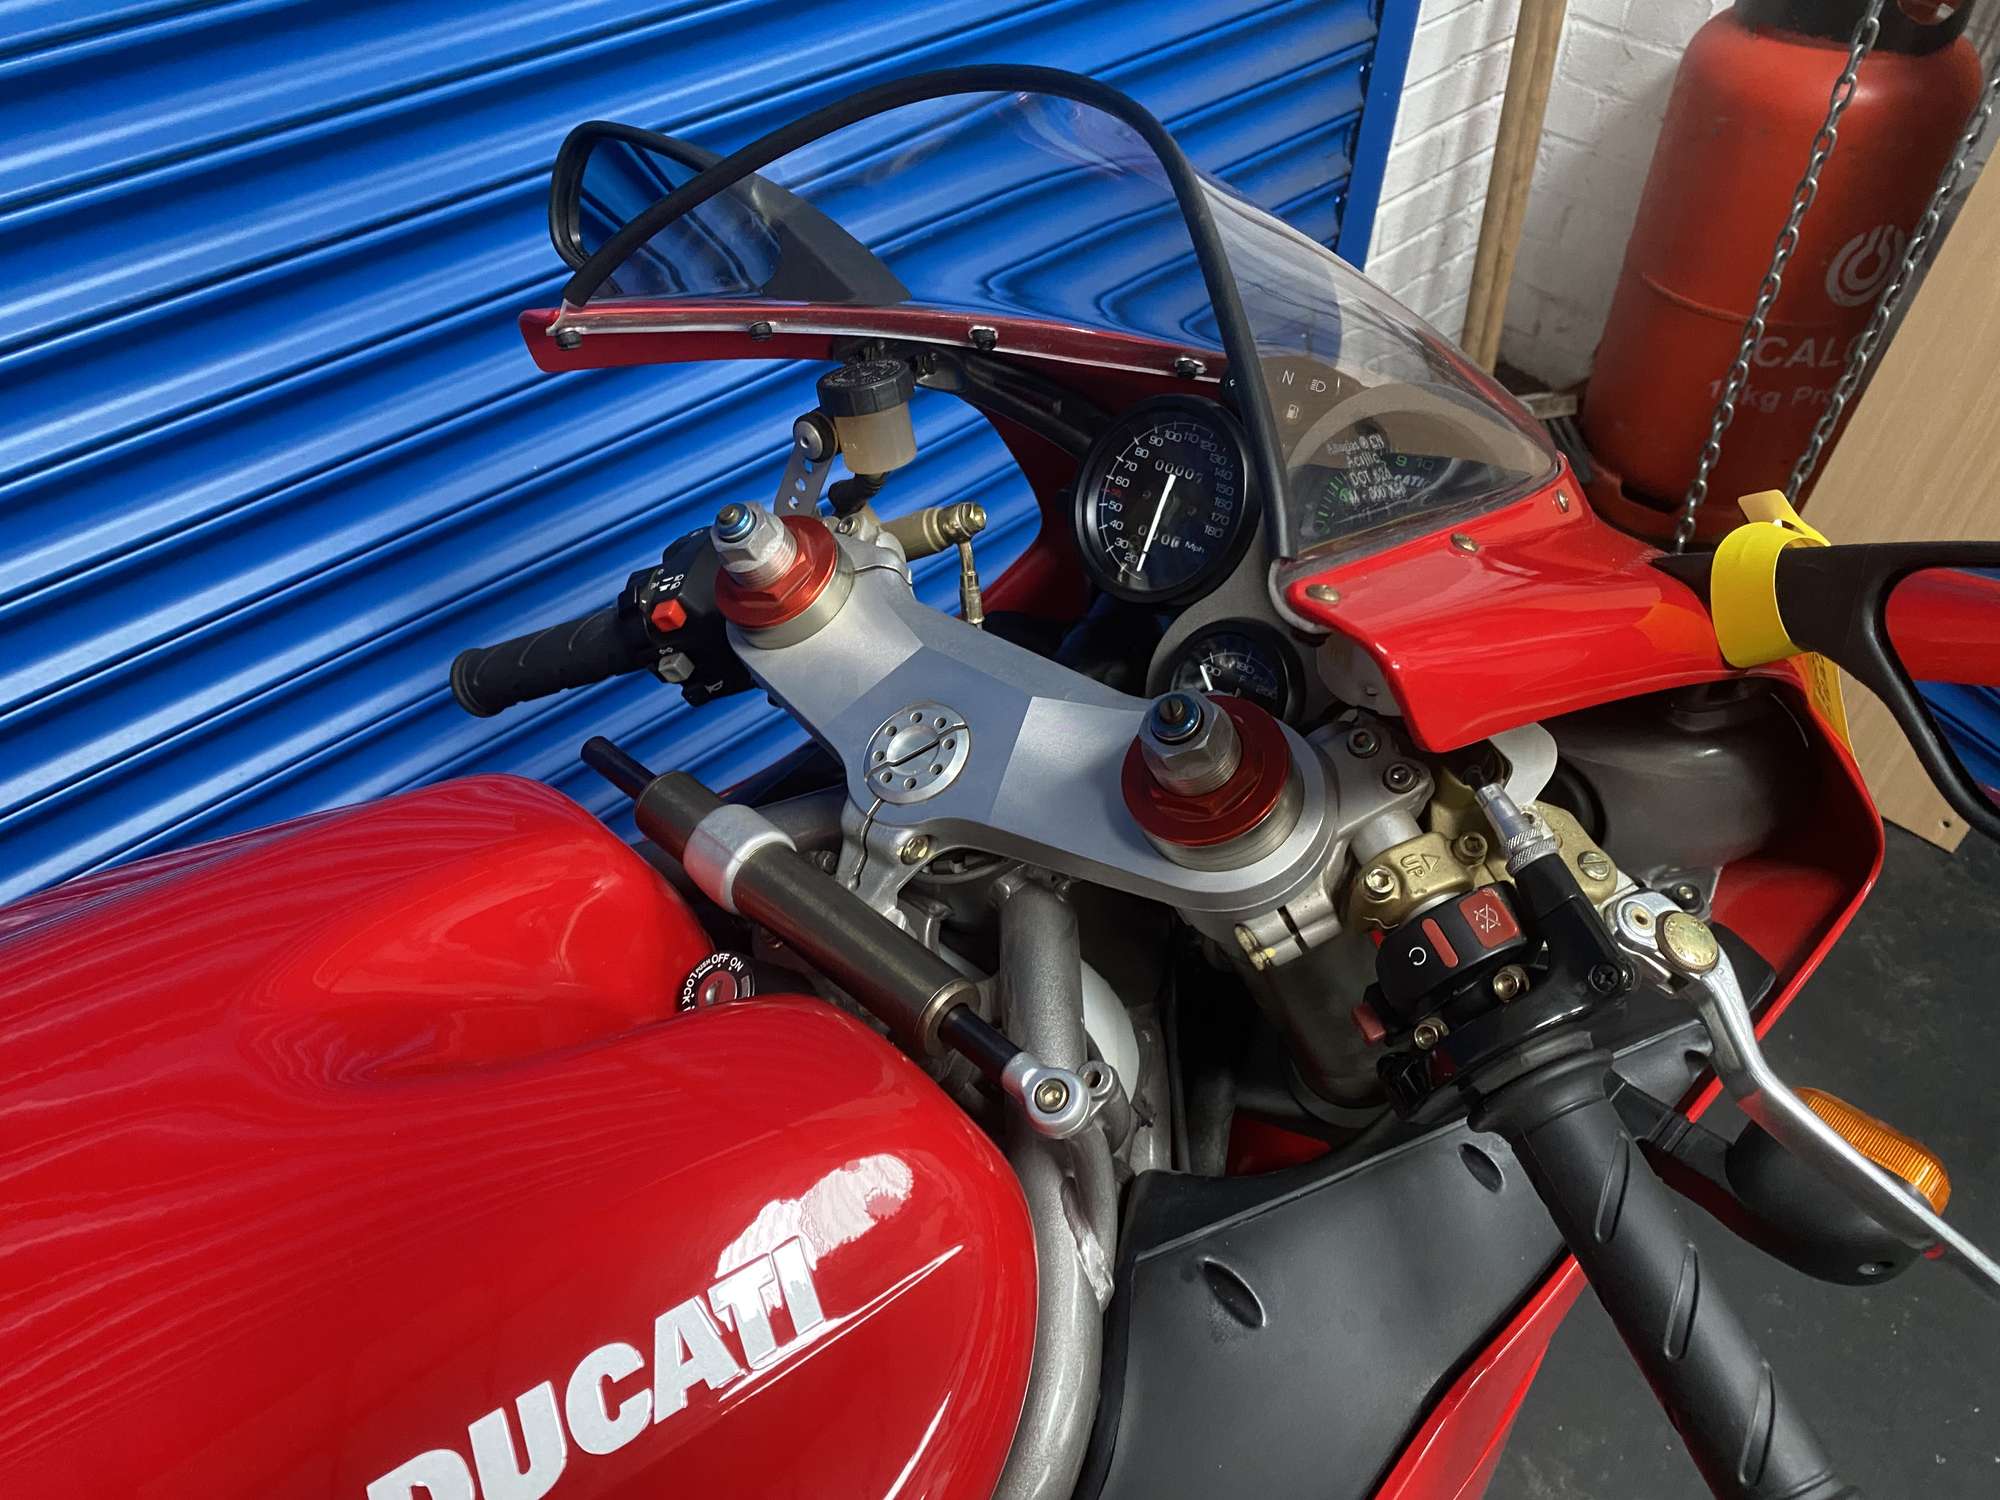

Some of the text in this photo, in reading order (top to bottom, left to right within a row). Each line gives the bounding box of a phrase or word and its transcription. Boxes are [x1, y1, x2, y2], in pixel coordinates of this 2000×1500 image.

[1149, 435, 1164, 448] 90
[1164, 429, 1183, 443] 100
[1184, 431, 1200, 444] 110
[1134, 447, 1149, 459] 80
[1201, 439, 1217, 453] 120
[1123, 460, 1138, 472] 70
[1210, 452, 1227, 466] 130
[1214, 467, 1233, 481] 140
[1115, 476, 1130, 488] 60
[1215, 482, 1234, 496] 150
[1108, 501, 1123, 512] 50
[1109, 519, 1124, 531] 40
[1211, 512, 1230, 526] 170
[1204, 524, 1224, 539] 180
[1114, 537, 1129, 550] 30
[1124, 551, 1138, 564] 20
[1203, 663, 1222, 677] 00
[1400, 853, 1425, 879] UP
[711, 953, 730, 965] OFF
[730, 957, 744, 972] ON
[681, 972, 698, 1005] LOCK
